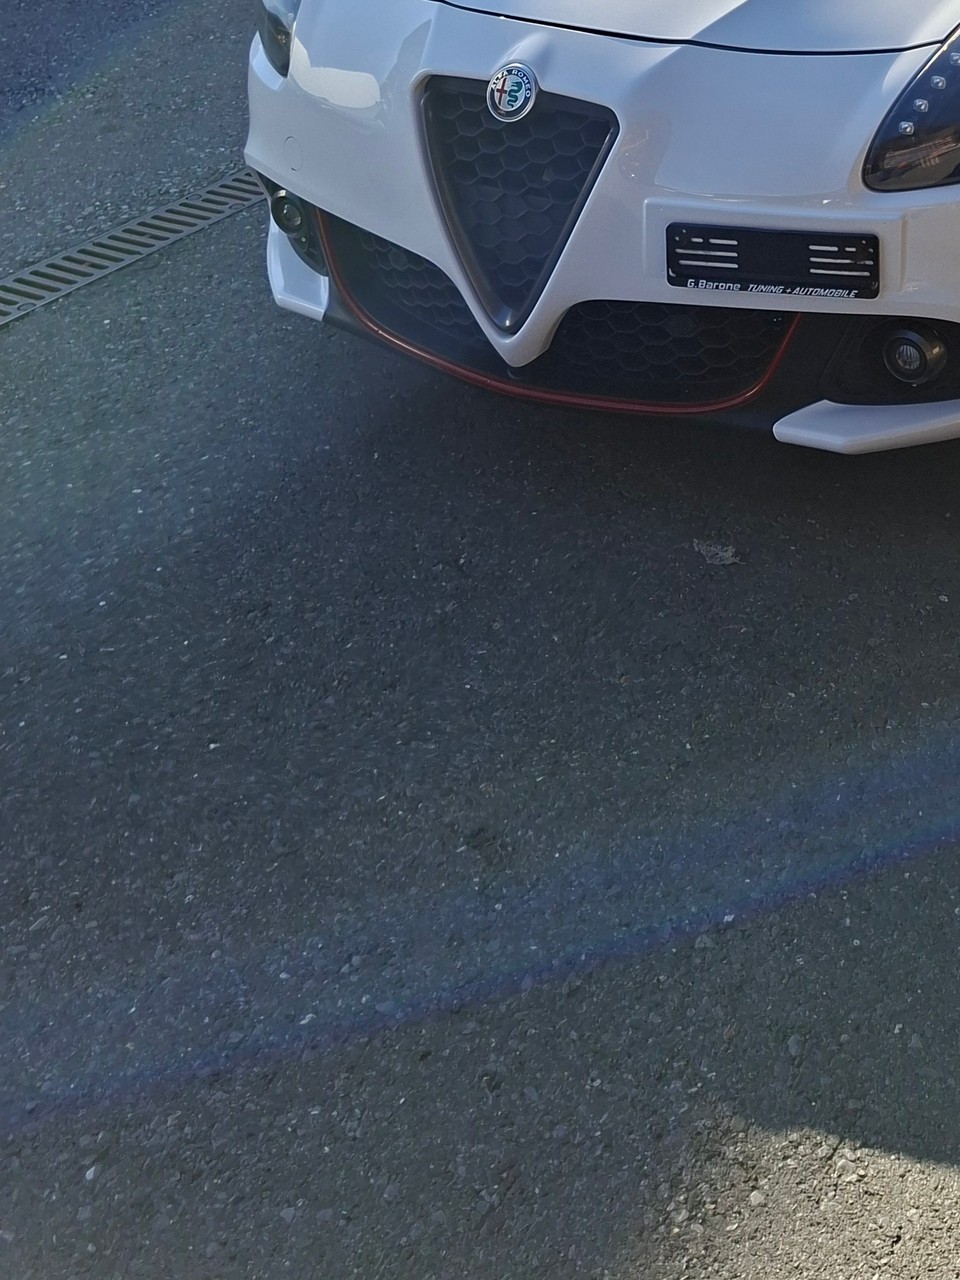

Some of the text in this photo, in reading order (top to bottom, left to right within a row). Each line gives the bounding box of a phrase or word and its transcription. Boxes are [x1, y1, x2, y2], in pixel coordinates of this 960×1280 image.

[511, 69, 531, 98] ROMEO
[687, 278, 741, 291] G.Barone
[747, 283, 785, 294] TUNING
[792, 286, 859, 299] AUTOMOBILE
